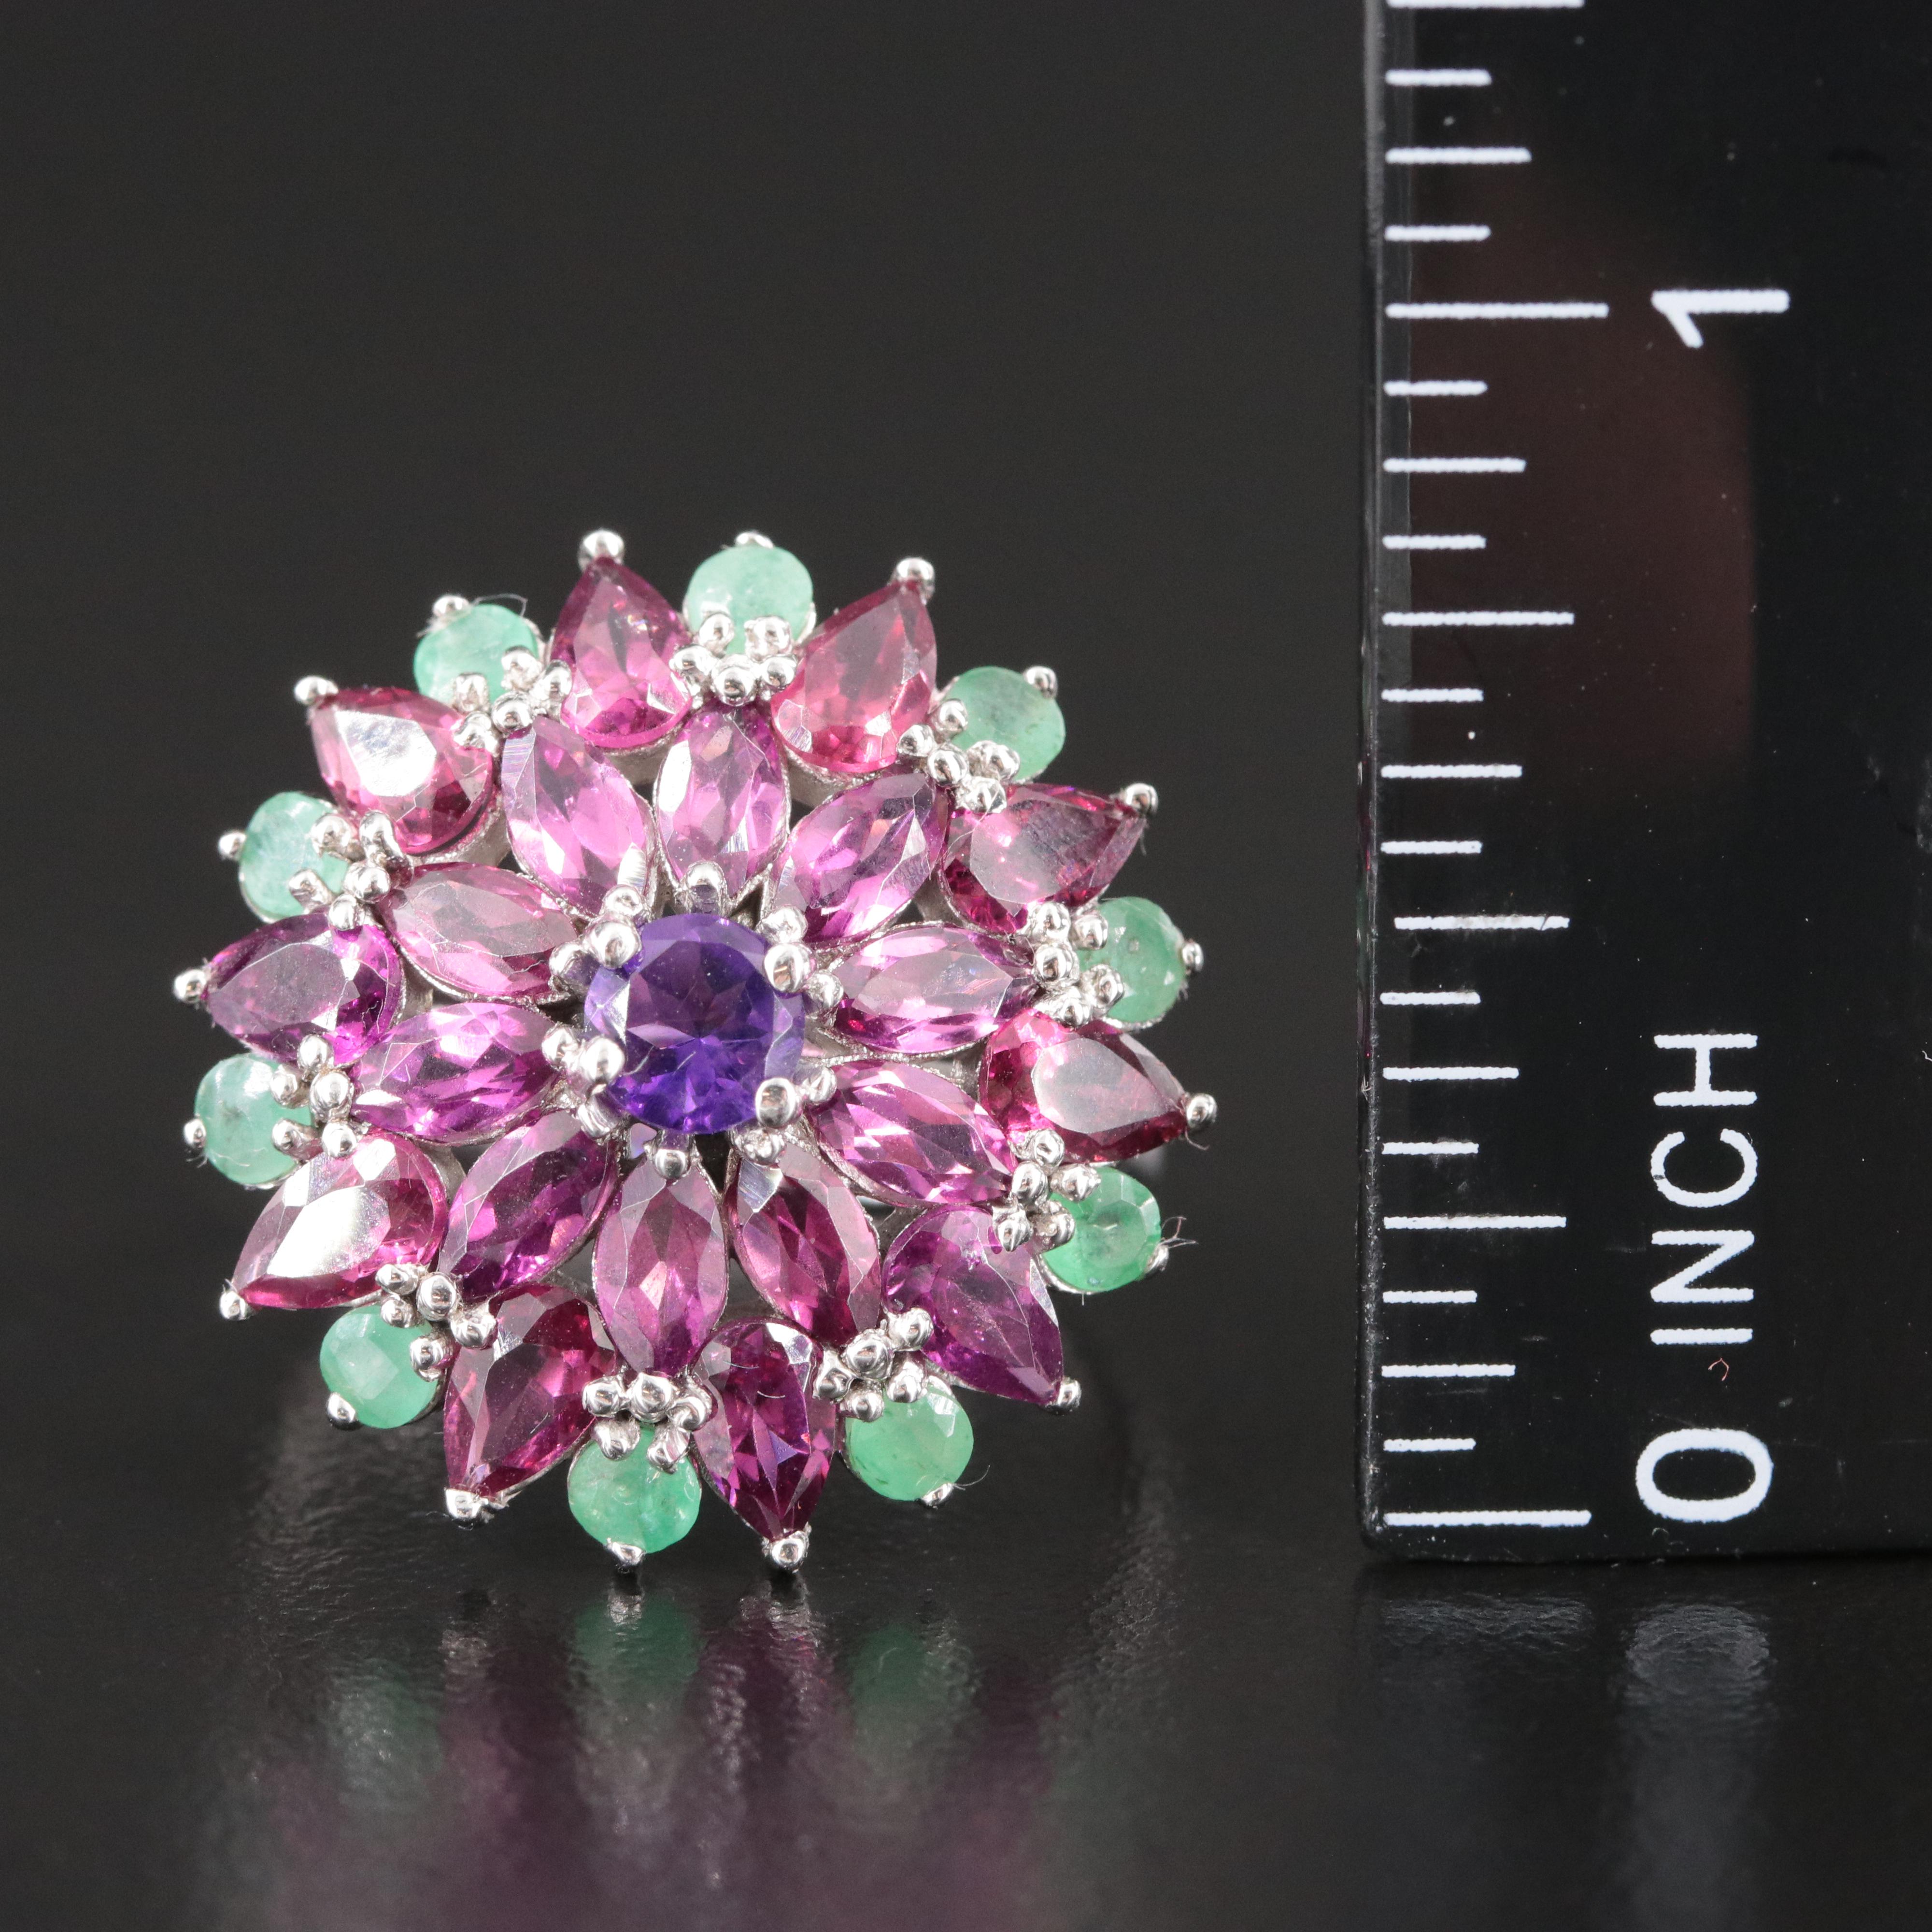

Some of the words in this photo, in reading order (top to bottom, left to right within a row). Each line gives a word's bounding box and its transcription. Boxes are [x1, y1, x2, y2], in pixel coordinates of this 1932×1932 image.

[1651, 289, 1790, 348] 1
[1650, 1033, 1758, 1345] INCH
[1635, 1427, 1774, 1523] 0
